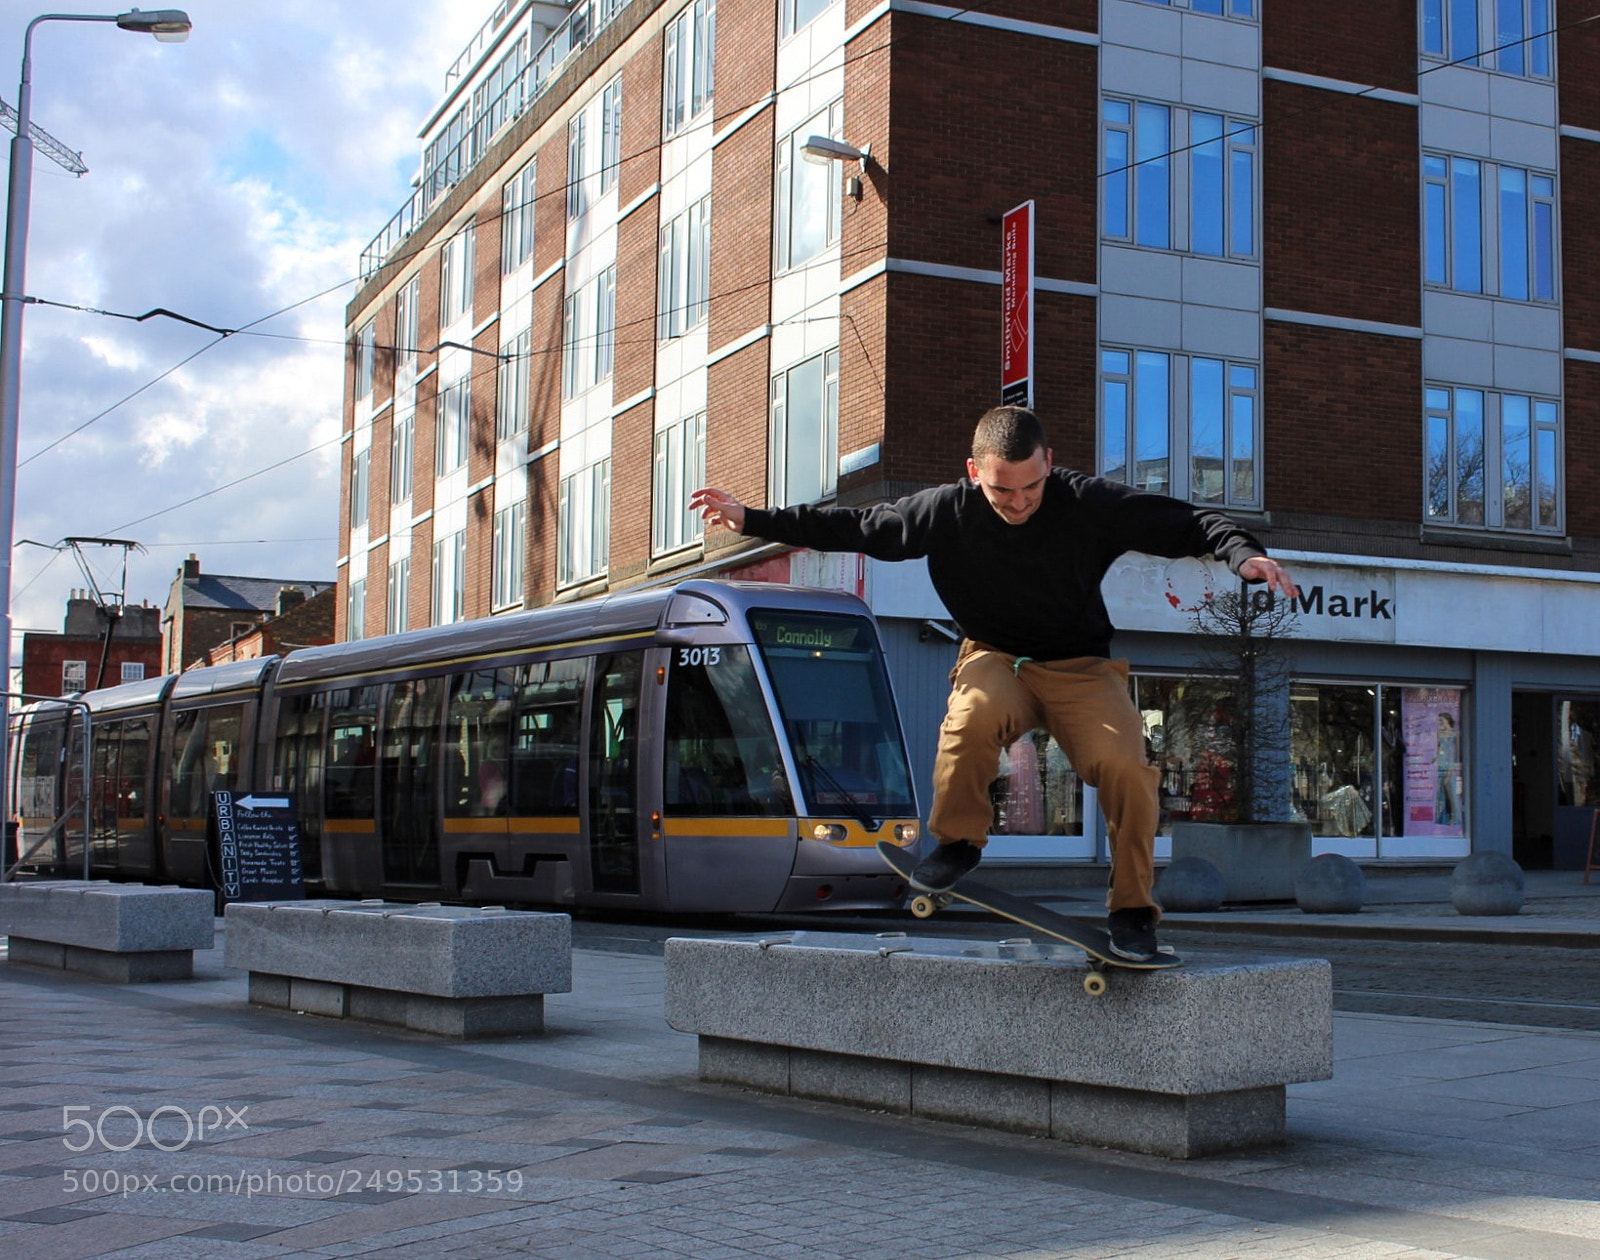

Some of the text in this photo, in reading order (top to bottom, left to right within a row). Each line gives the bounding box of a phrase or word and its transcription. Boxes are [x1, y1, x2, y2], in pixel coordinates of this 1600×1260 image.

[1004, 287, 1012, 371] Smithfield
[1291, 584, 1396, 620] Mark
[777, 626, 832, 647] Connolly
[679, 647, 721, 667] 3013
[217, 792, 237, 897] URBANITY
